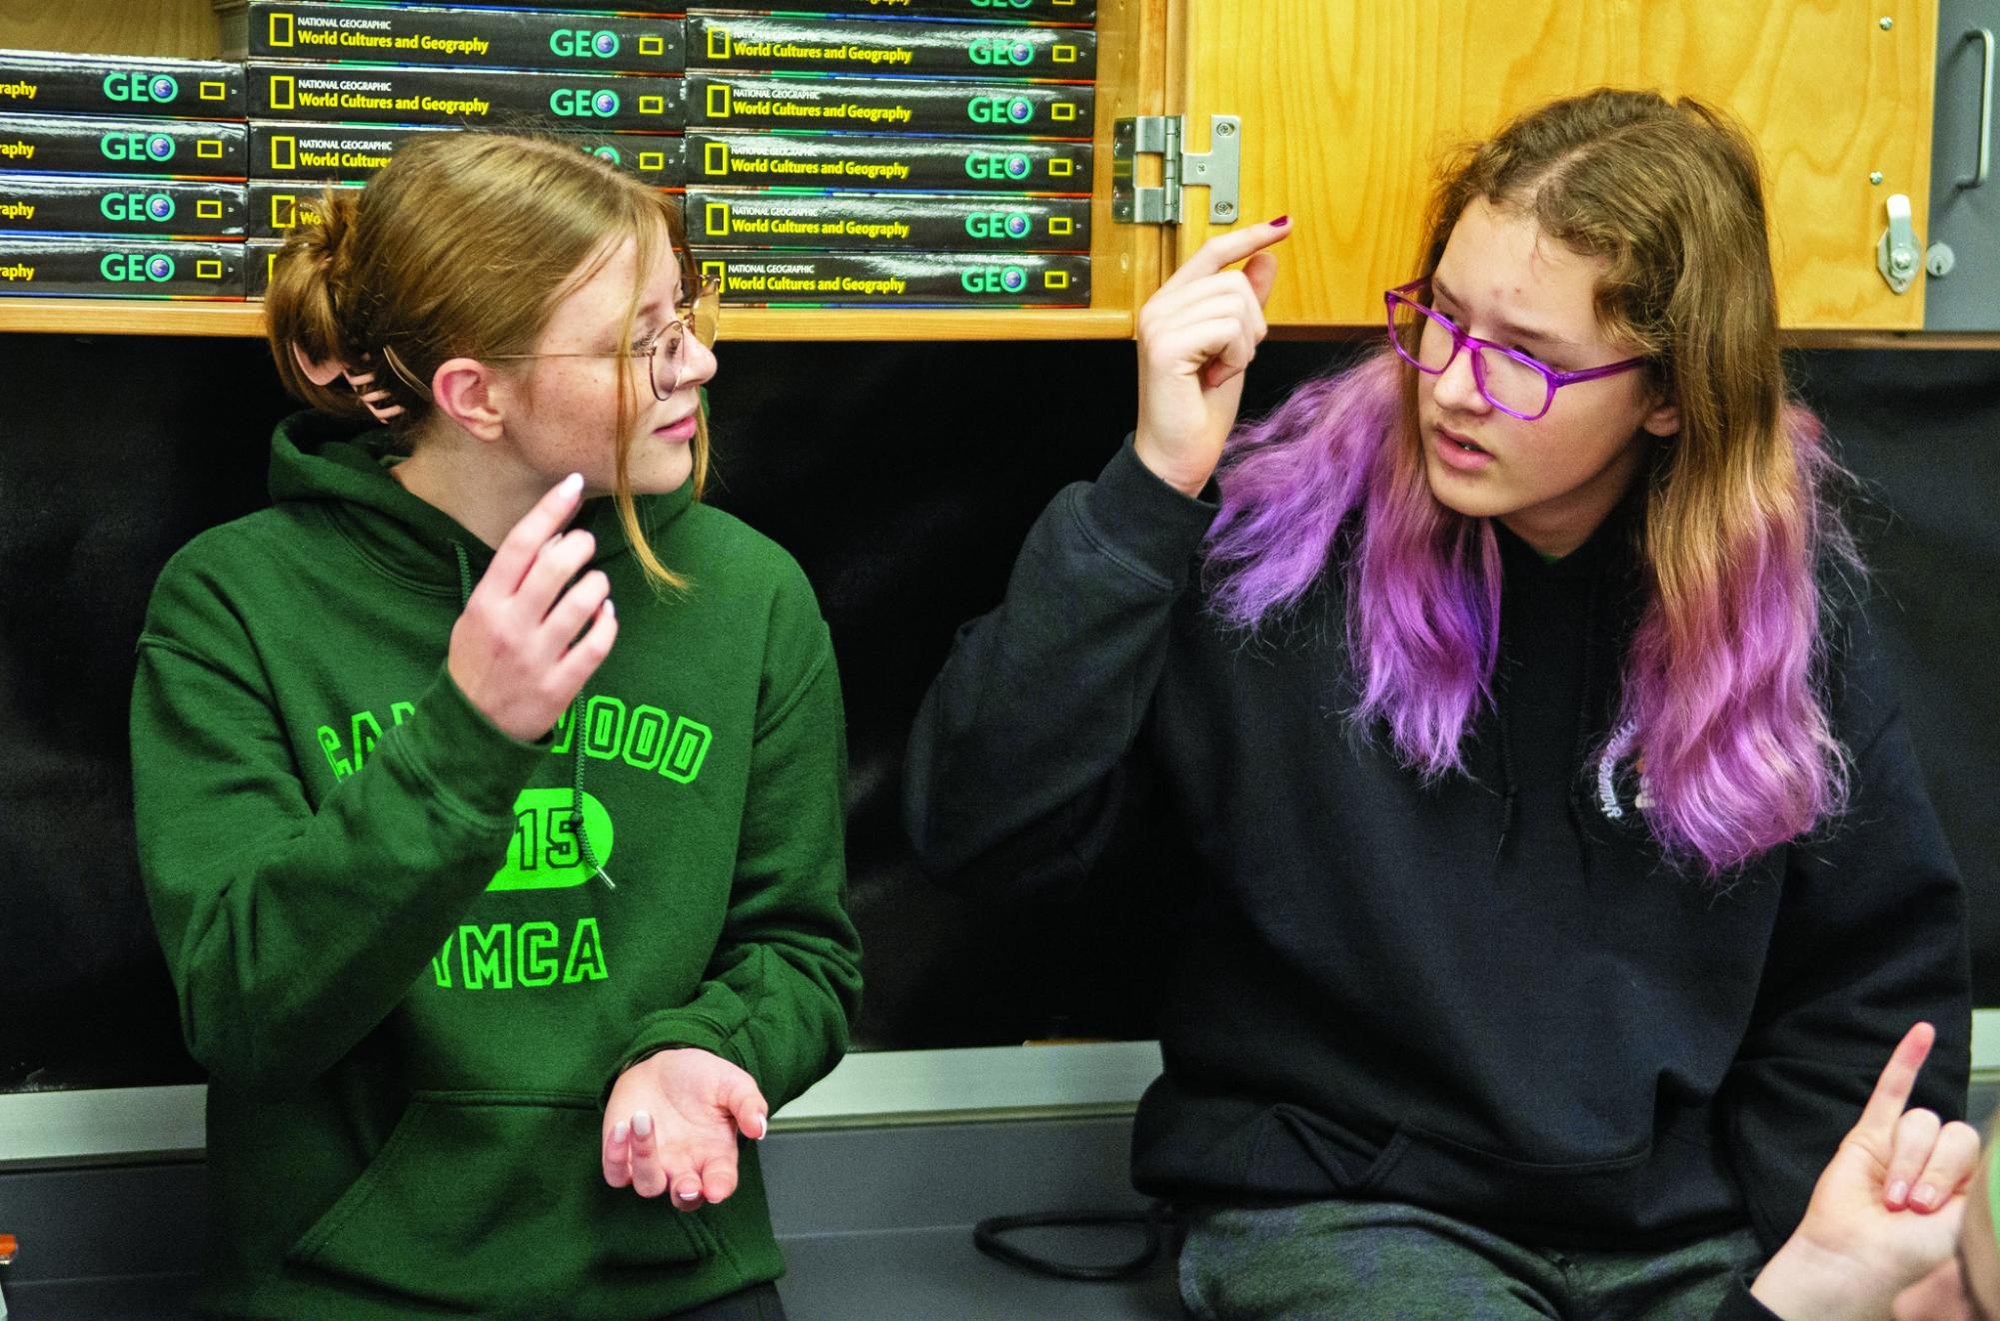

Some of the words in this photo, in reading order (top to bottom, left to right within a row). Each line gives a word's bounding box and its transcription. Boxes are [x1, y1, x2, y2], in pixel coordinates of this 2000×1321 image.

[297, 16, 339, 28] NATIONAL
[340, 18, 392, 30] GEOGRAPHIC
[297, 30, 338, 45] World
[339, 32, 393, 48] Cultures
[394, 34, 419, 49] and
[420, 35, 489, 55] Geography
[549, 28, 621, 58] GEO
[733, 42, 771, 57] World
[772, 43, 823, 58] Cultures
[823, 46, 847, 59] and
[848, 46, 912, 64] Geography
[968, 38, 1035, 66] GEO
[103, 72, 179, 103] GEO
[298, 79, 339, 91] NATIONAL
[340, 80, 392, 92] GEOGRAPHIC
[733, 88, 771, 98] NATIONAL
[772, 89, 820, 100] GEOGRAPHIC
[298, 92, 339, 107] World
[340, 94, 393, 109] Cultures
[394, 95, 420, 110] and
[421, 96, 489, 115] Geography
[549, 88, 621, 118] GEO
[733, 101, 771, 115] World
[772, 102, 822, 117] Cultures
[822, 104, 847, 118] and
[847, 104, 912, 123] Geography
[967, 96, 1034, 124] GEO
[100, 131, 176, 162] GEO
[299, 139, 340, 149] NATIONAL
[340, 140, 393, 151] GEOGRAPHIC
[299, 152, 340, 167] World
[730, 159, 769, 173] World
[769, 159, 820, 174] Cultures
[820, 161, 845, 175] and
[845, 161, 909, 179] Geography
[964, 152, 1032, 180] GEO
[100, 193, 176, 222] GEO
[731, 207, 769, 216] NATIONAL
[770, 208, 818, 218] GEOGRAPHIC
[731, 219, 770, 233] World
[770, 219, 820, 234] Cultures
[821, 221, 845, 234] and
[845, 221, 910, 239] Geography
[965, 211, 1032, 239] GEO
[100, 253, 176, 283] GEO
[727, 264, 766, 274] NATIONAL
[766, 264, 815, 275] GEOGRAPHIC
[960, 265, 1027, 293] GEO
[727, 276, 766, 290] World
[766, 276, 817, 291] Cultures
[817, 277, 841, 291] and
[841, 277, 906, 294] Geography
[551, 695, 713, 784] OOD
[516, 807, 583, 871] 15
